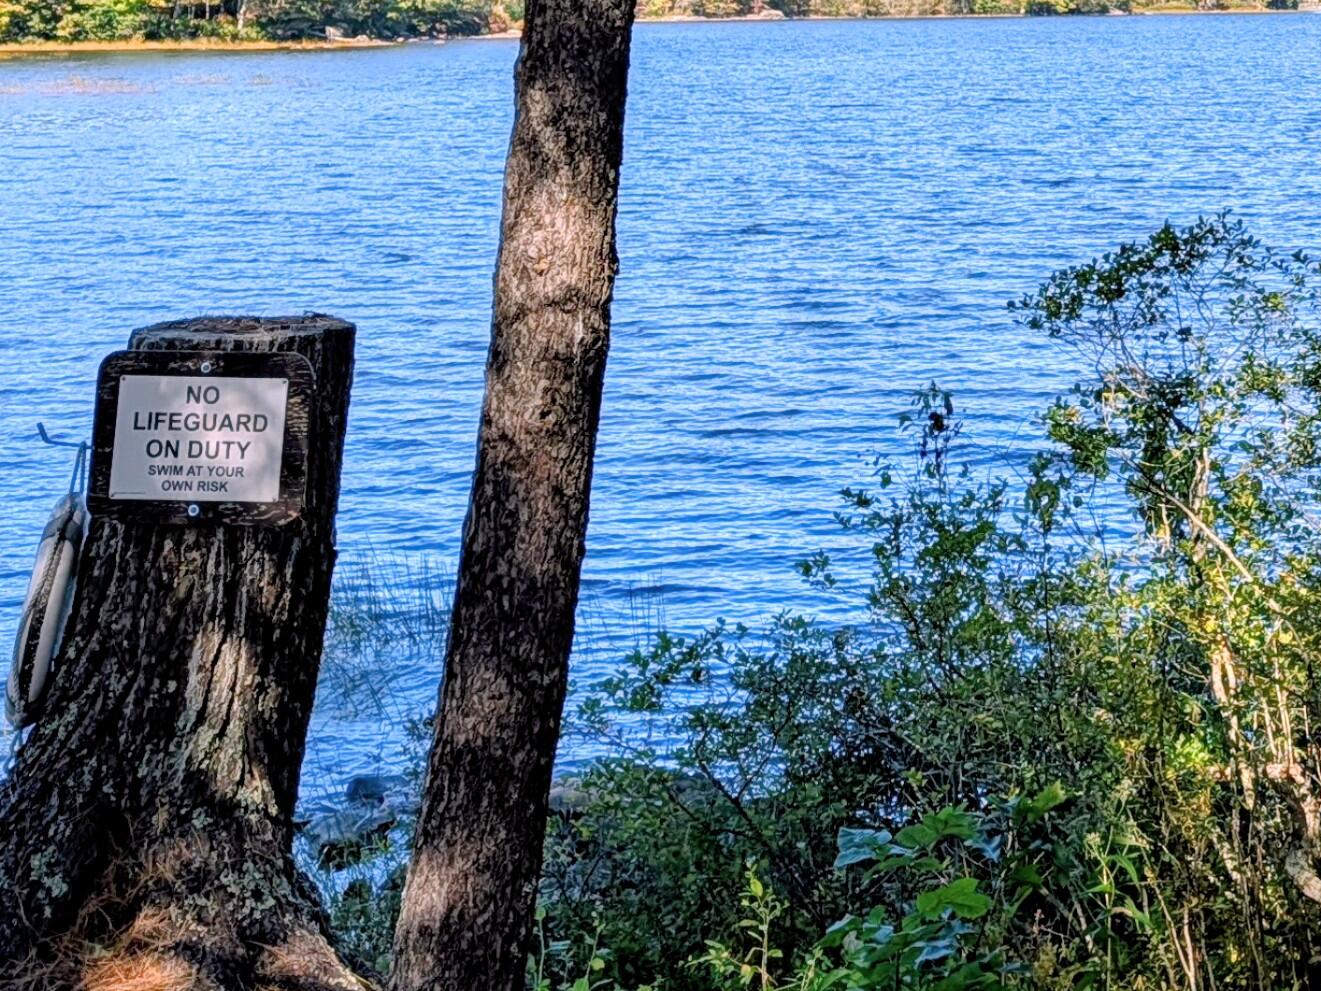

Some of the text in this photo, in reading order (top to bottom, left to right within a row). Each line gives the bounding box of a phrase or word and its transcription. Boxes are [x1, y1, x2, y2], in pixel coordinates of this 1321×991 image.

[186, 385, 220, 405] NO
[133, 411, 268, 433] LIFEGUARD
[146, 439, 252, 459] ON DUTY
[148, 464, 244, 478] SWIM AT YOUR
[161, 480, 229, 493] OWN RISK
